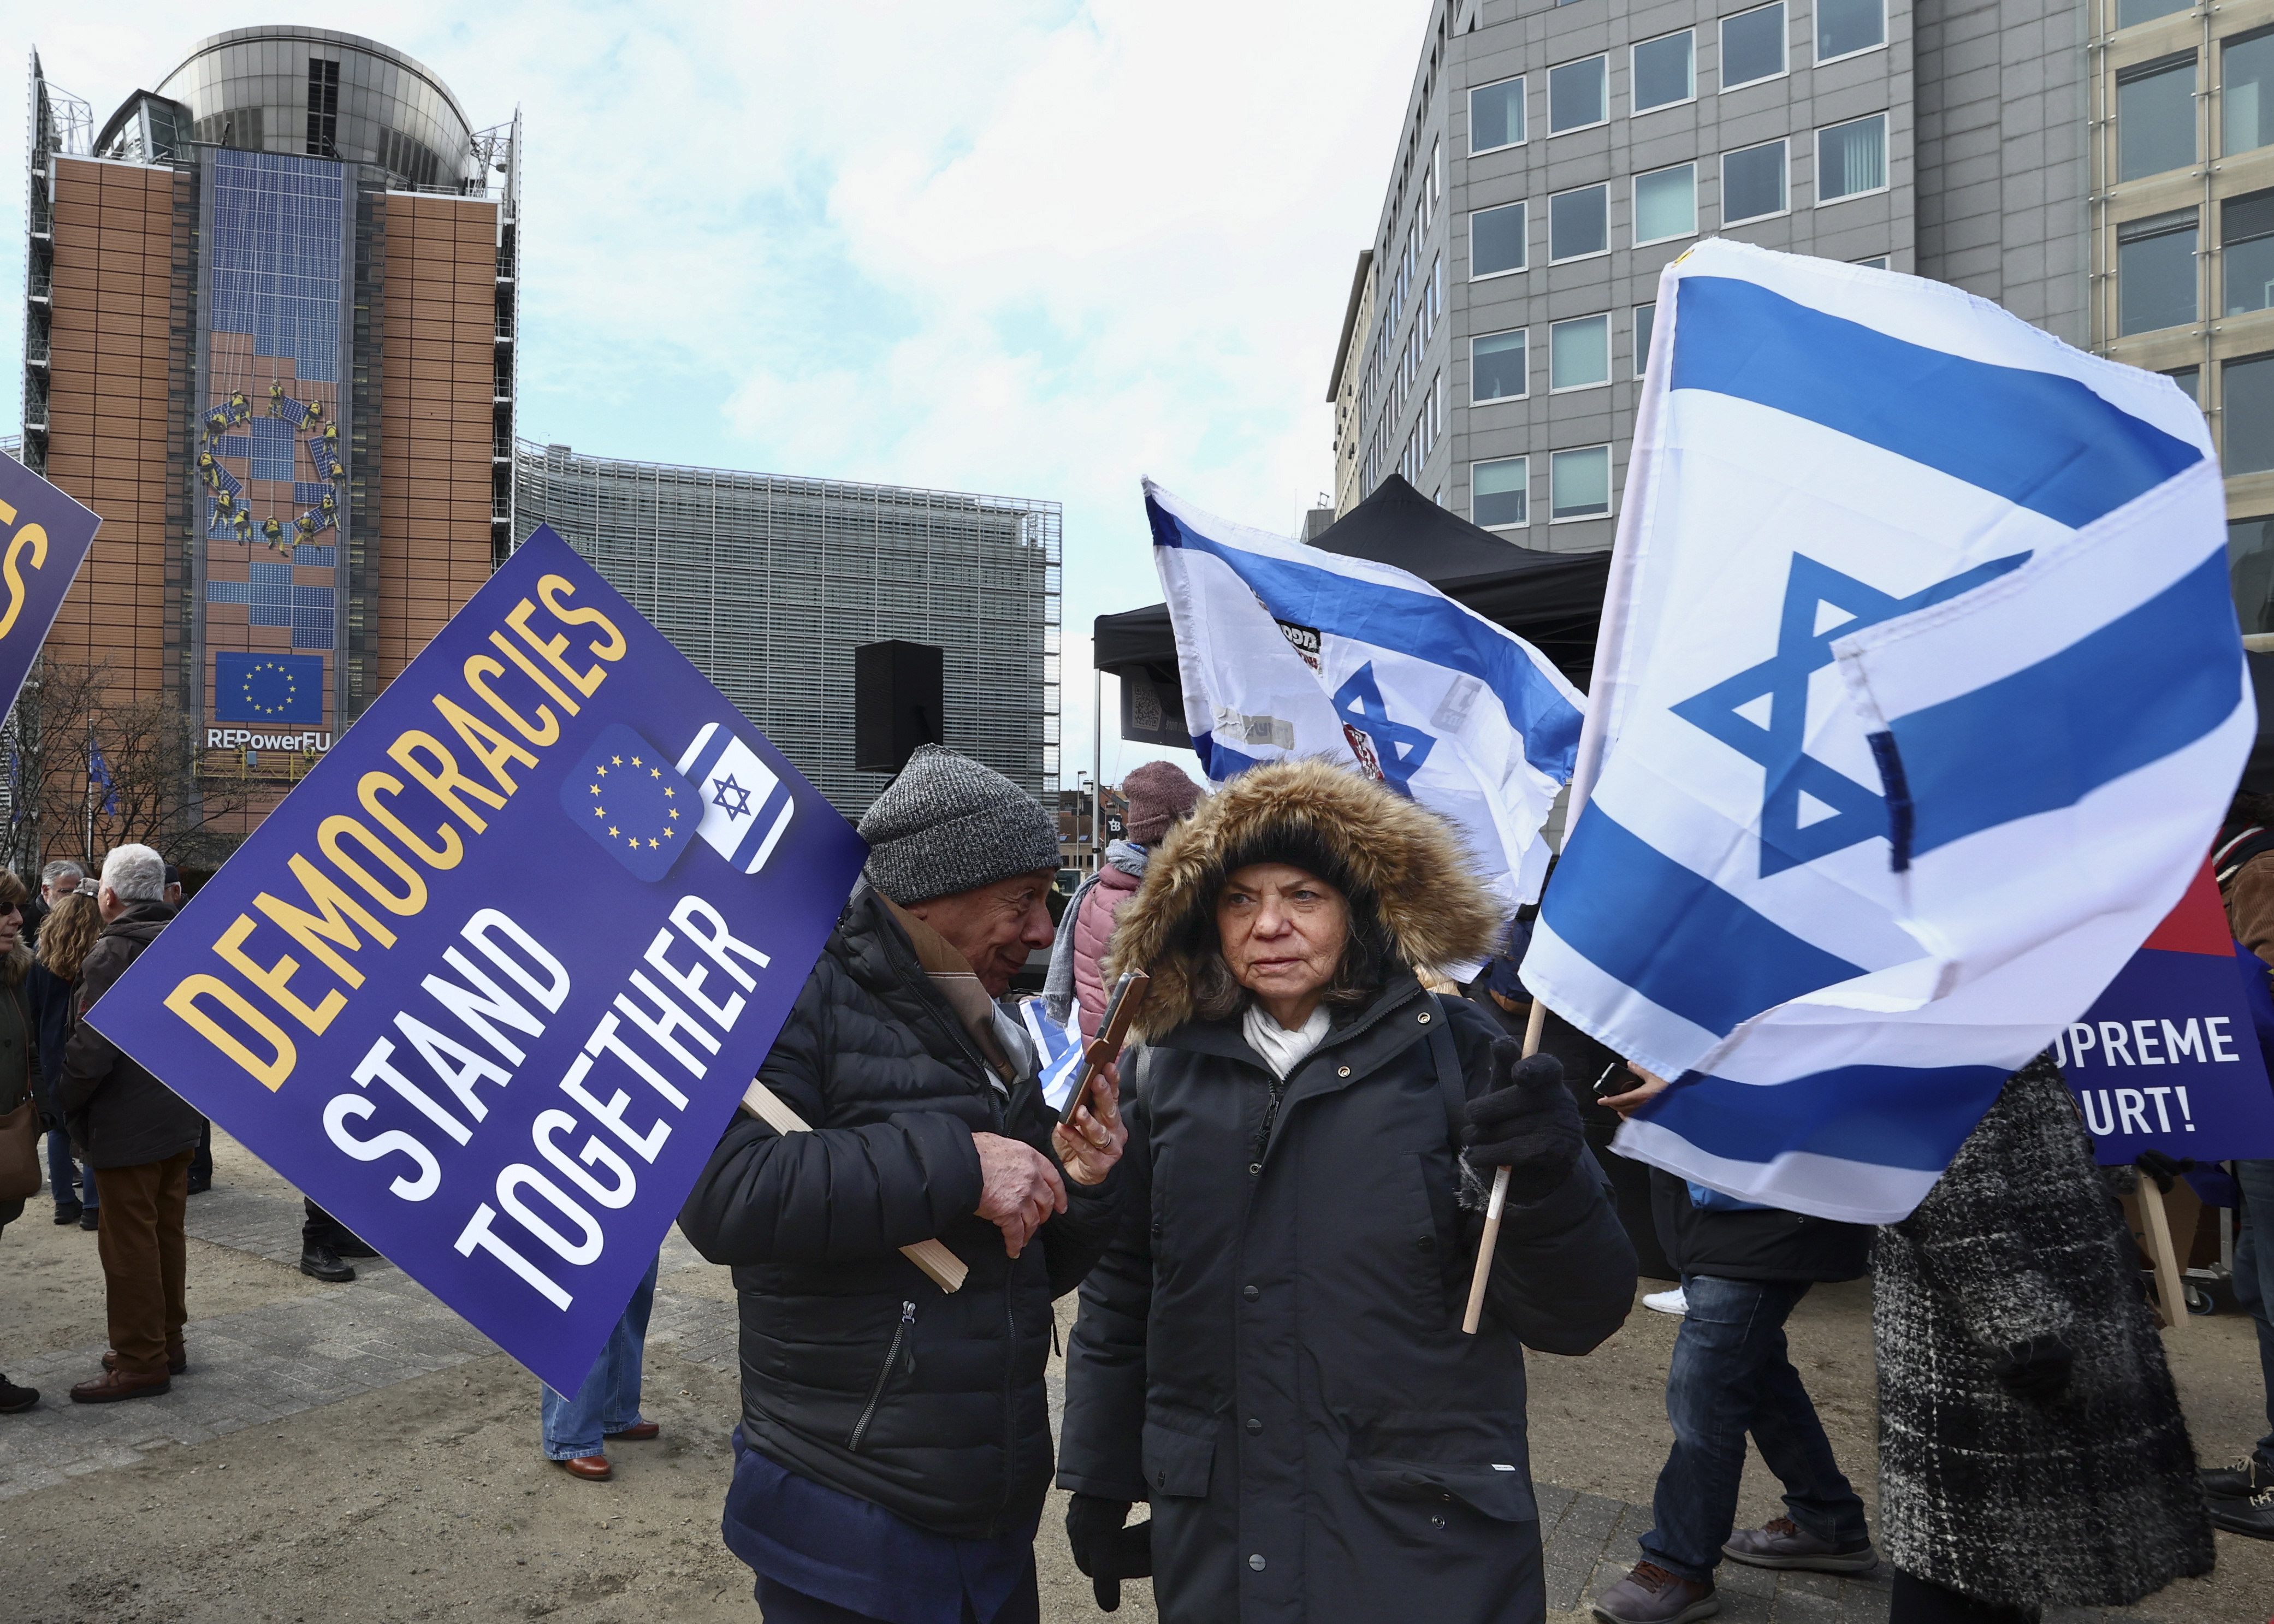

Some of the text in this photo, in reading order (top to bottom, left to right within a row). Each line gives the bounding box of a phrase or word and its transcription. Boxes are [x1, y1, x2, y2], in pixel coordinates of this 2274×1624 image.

[0, 499, 48, 640] S
[165, 574, 626, 1091] DEMOCRACIES
[208, 729, 330, 751] REPowerEU
[323, 908, 570, 1201] STAND
[453, 895, 771, 1312] TOGETHER
